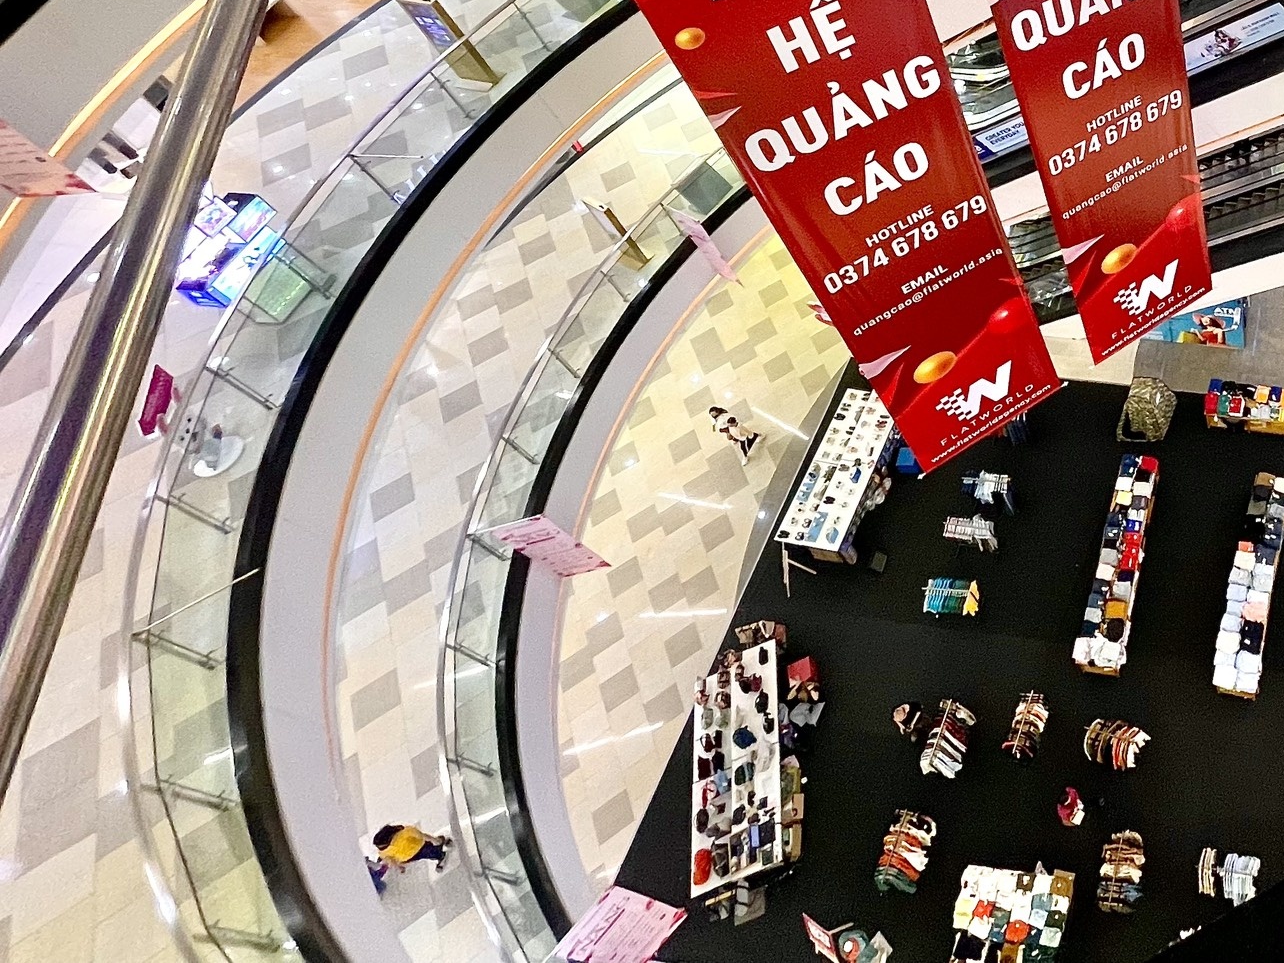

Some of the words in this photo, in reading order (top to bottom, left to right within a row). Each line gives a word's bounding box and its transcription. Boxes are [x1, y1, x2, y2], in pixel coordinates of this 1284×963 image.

[1062, 33, 1145, 99] CÁO
[744, 56, 941, 172] QUẢNG
[1048, 134, 1102, 176] 0374
[1104, 112, 1143, 145] 678
[1146, 90, 1183, 123] 679
[1086, 94, 1143, 133] HOTLINE
[824, 141, 930, 217] CÁO
[1105, 156, 1144, 183] EMAIL
[824, 248, 890, 294] 0374
[892, 223, 939, 258] 678
[941, 195, 987, 230] 679
[866, 205, 934, 247] HOTLINE
[853, 247, 1003, 336] quangcao@flatworld.asia
[901, 264, 949, 295] EMAIL
